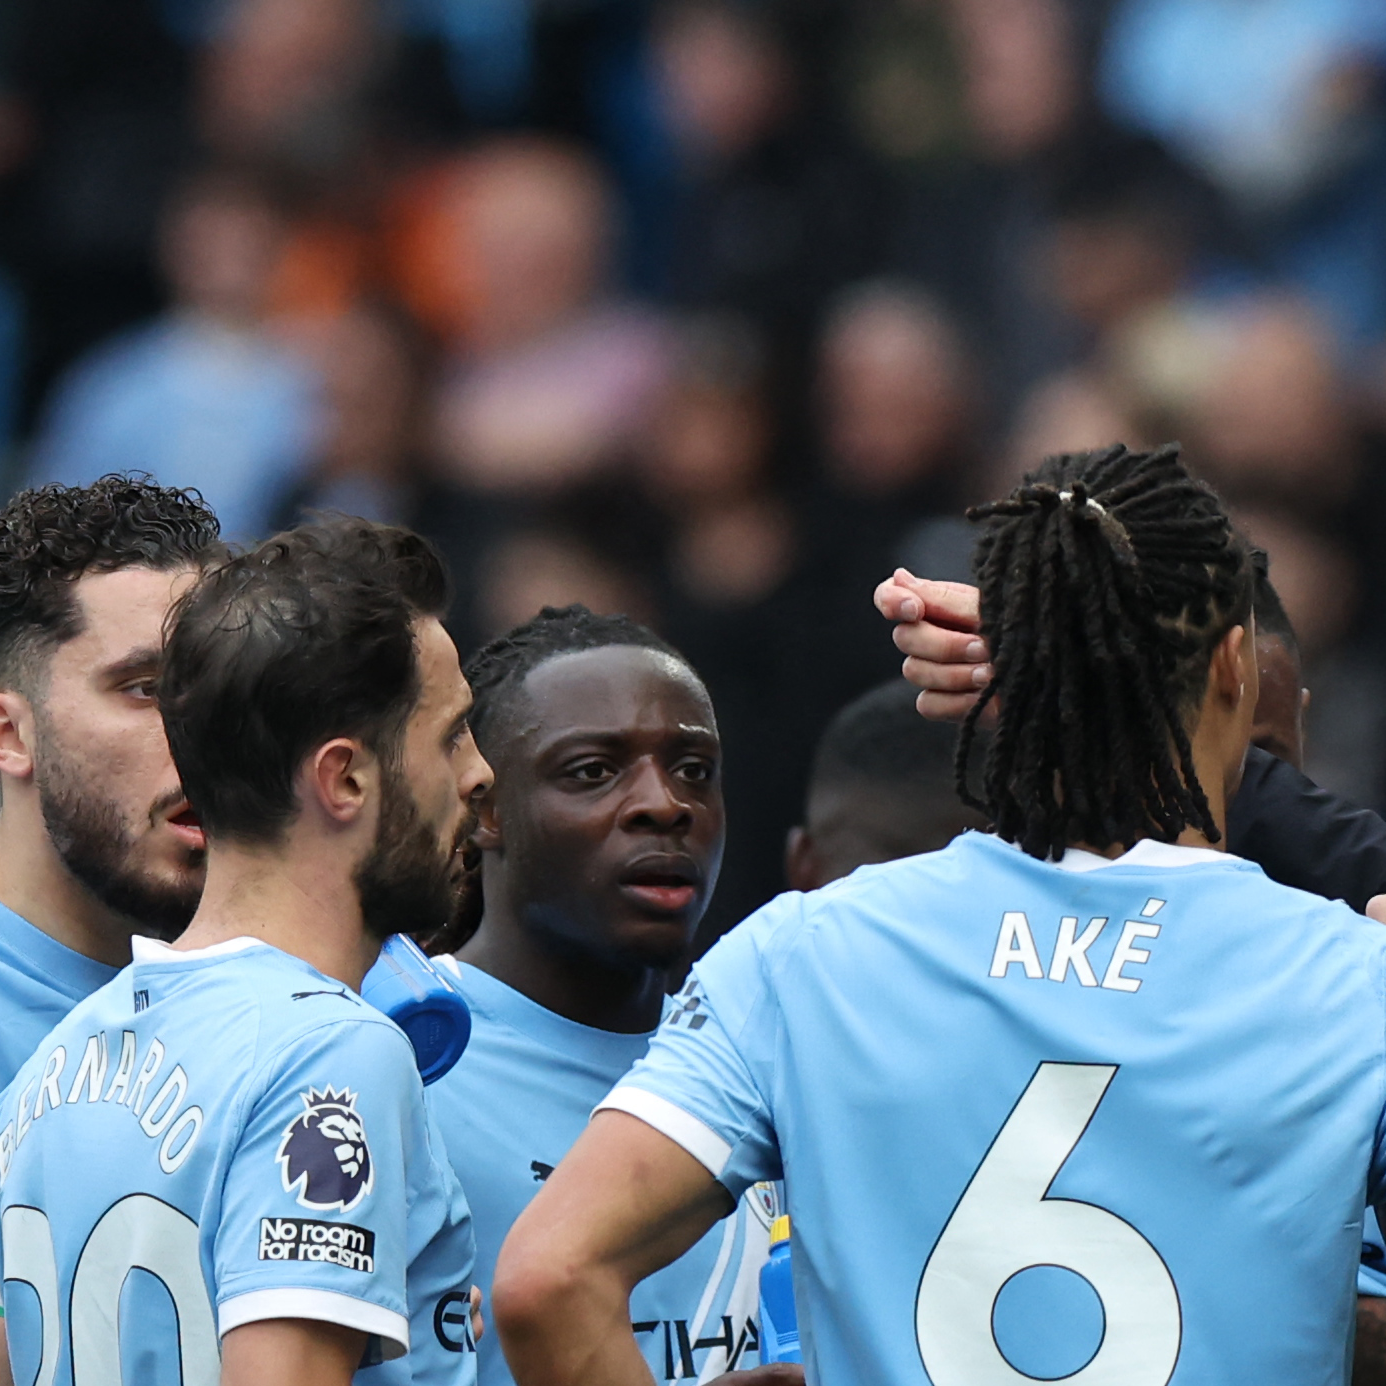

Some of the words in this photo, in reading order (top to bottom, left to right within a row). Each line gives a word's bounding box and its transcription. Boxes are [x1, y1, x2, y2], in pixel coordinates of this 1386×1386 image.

[988, 897, 1167, 993] AKÉ
[261, 1218, 298, 1241] No
[301, 1223, 365, 1252] room
[258, 1239, 295, 1260] for
[297, 1242, 374, 1273] racism
